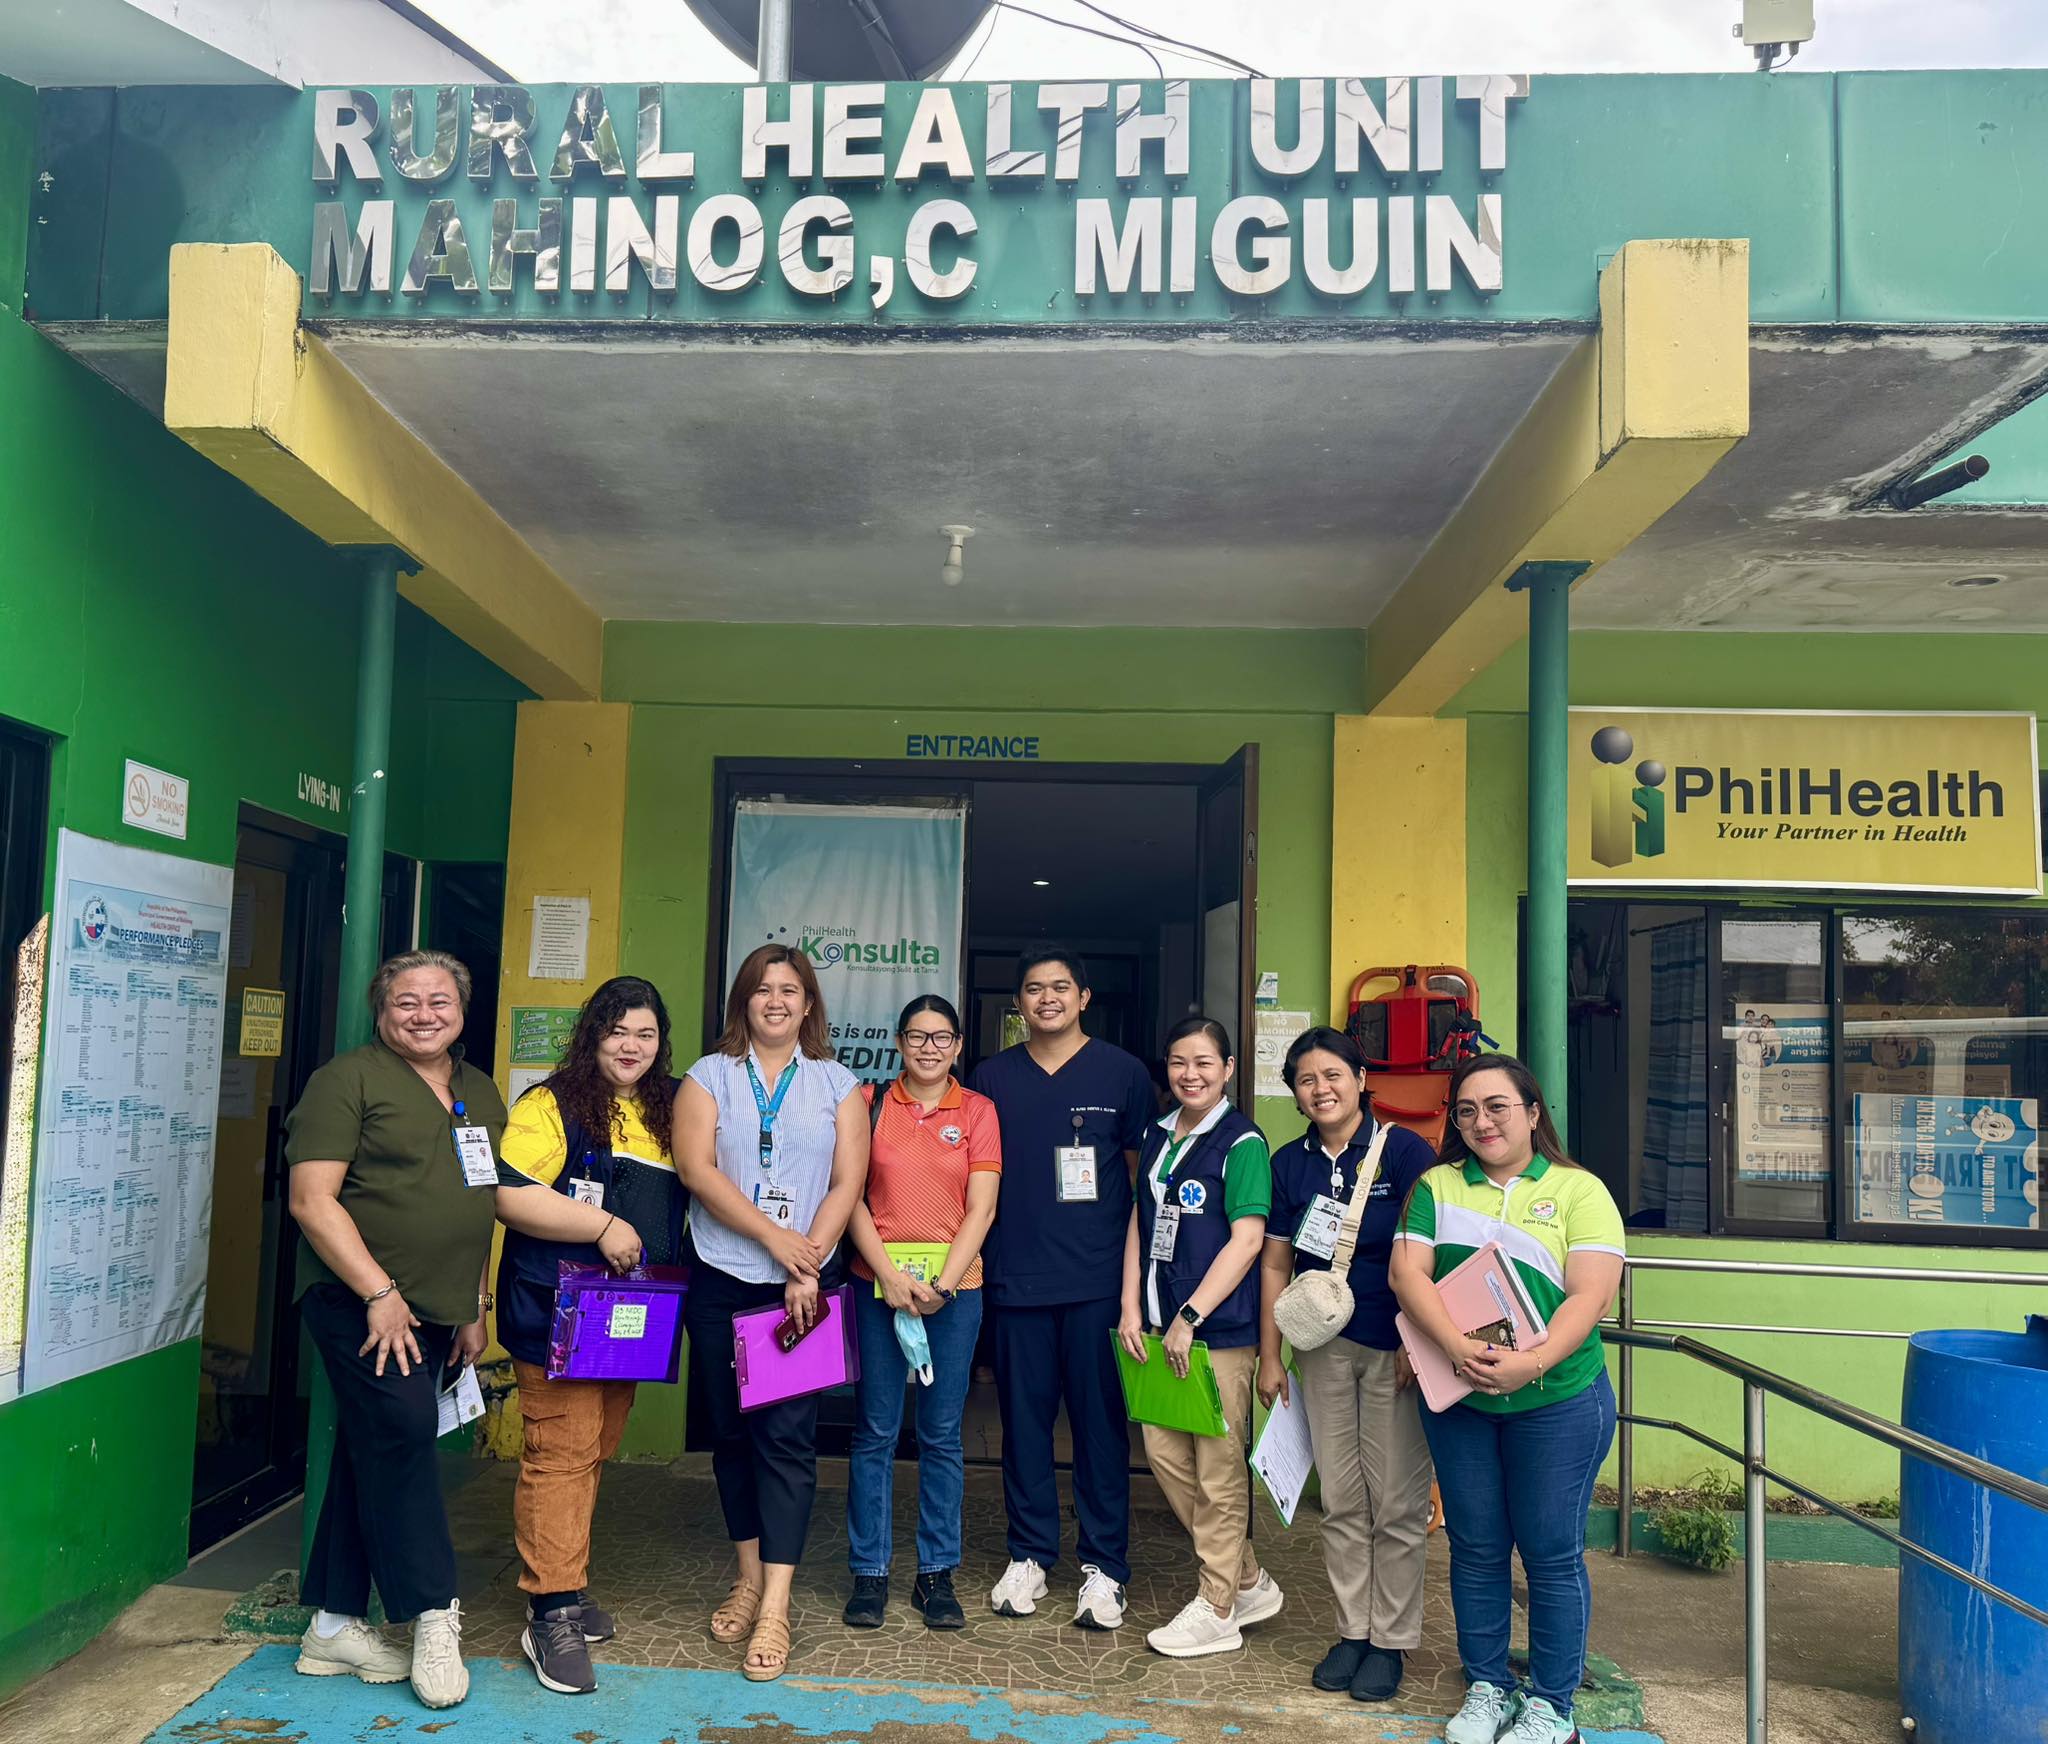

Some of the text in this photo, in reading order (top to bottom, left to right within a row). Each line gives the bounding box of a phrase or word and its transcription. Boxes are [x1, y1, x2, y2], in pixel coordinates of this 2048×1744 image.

[310, 74, 1530, 183] RURAL HEALTH UNIT
[1074, 194, 1503, 296] MIGUIN
[906, 734, 1040, 758] ENTRANCE
[162, 781, 177, 798] NO
[298, 771, 341, 813] LYING-IN
[1675, 766, 2004, 817] PhilHealth
[151, 795, 184, 816] SMOKING
[1716, 821, 1968, 843] Your Partner in Health
[119, 928, 204, 950] PERFORMANCE PLEDGES
[802, 925, 856, 937] PhilHealth
[802, 936, 940, 965] Konsulta
[846, 965, 896, 974] Konsultasyong
[921, 966, 939, 974] Tama
[246, 994, 282, 1015] CAUTION
[827, 1022, 889, 1039] is is an
[1273, 1017, 1287, 1026] NO
[243, 1038, 279, 1051] KEEP OUT
[1791, 1048, 1808, 1057] ang
[837, 1046, 902, 1070] EDIT
[1890, 1097, 1905, 1121] Mura
[1916, 1100, 1936, 1113] AN
[1916, 1114, 1936, 1134] EGG
[1916, 1142, 1936, 1162] DAY
[1982, 1155, 1995, 1168] ITO
[1915, 1162, 1936, 1172] IS
[1982, 1169, 1995, 1185] ANG
